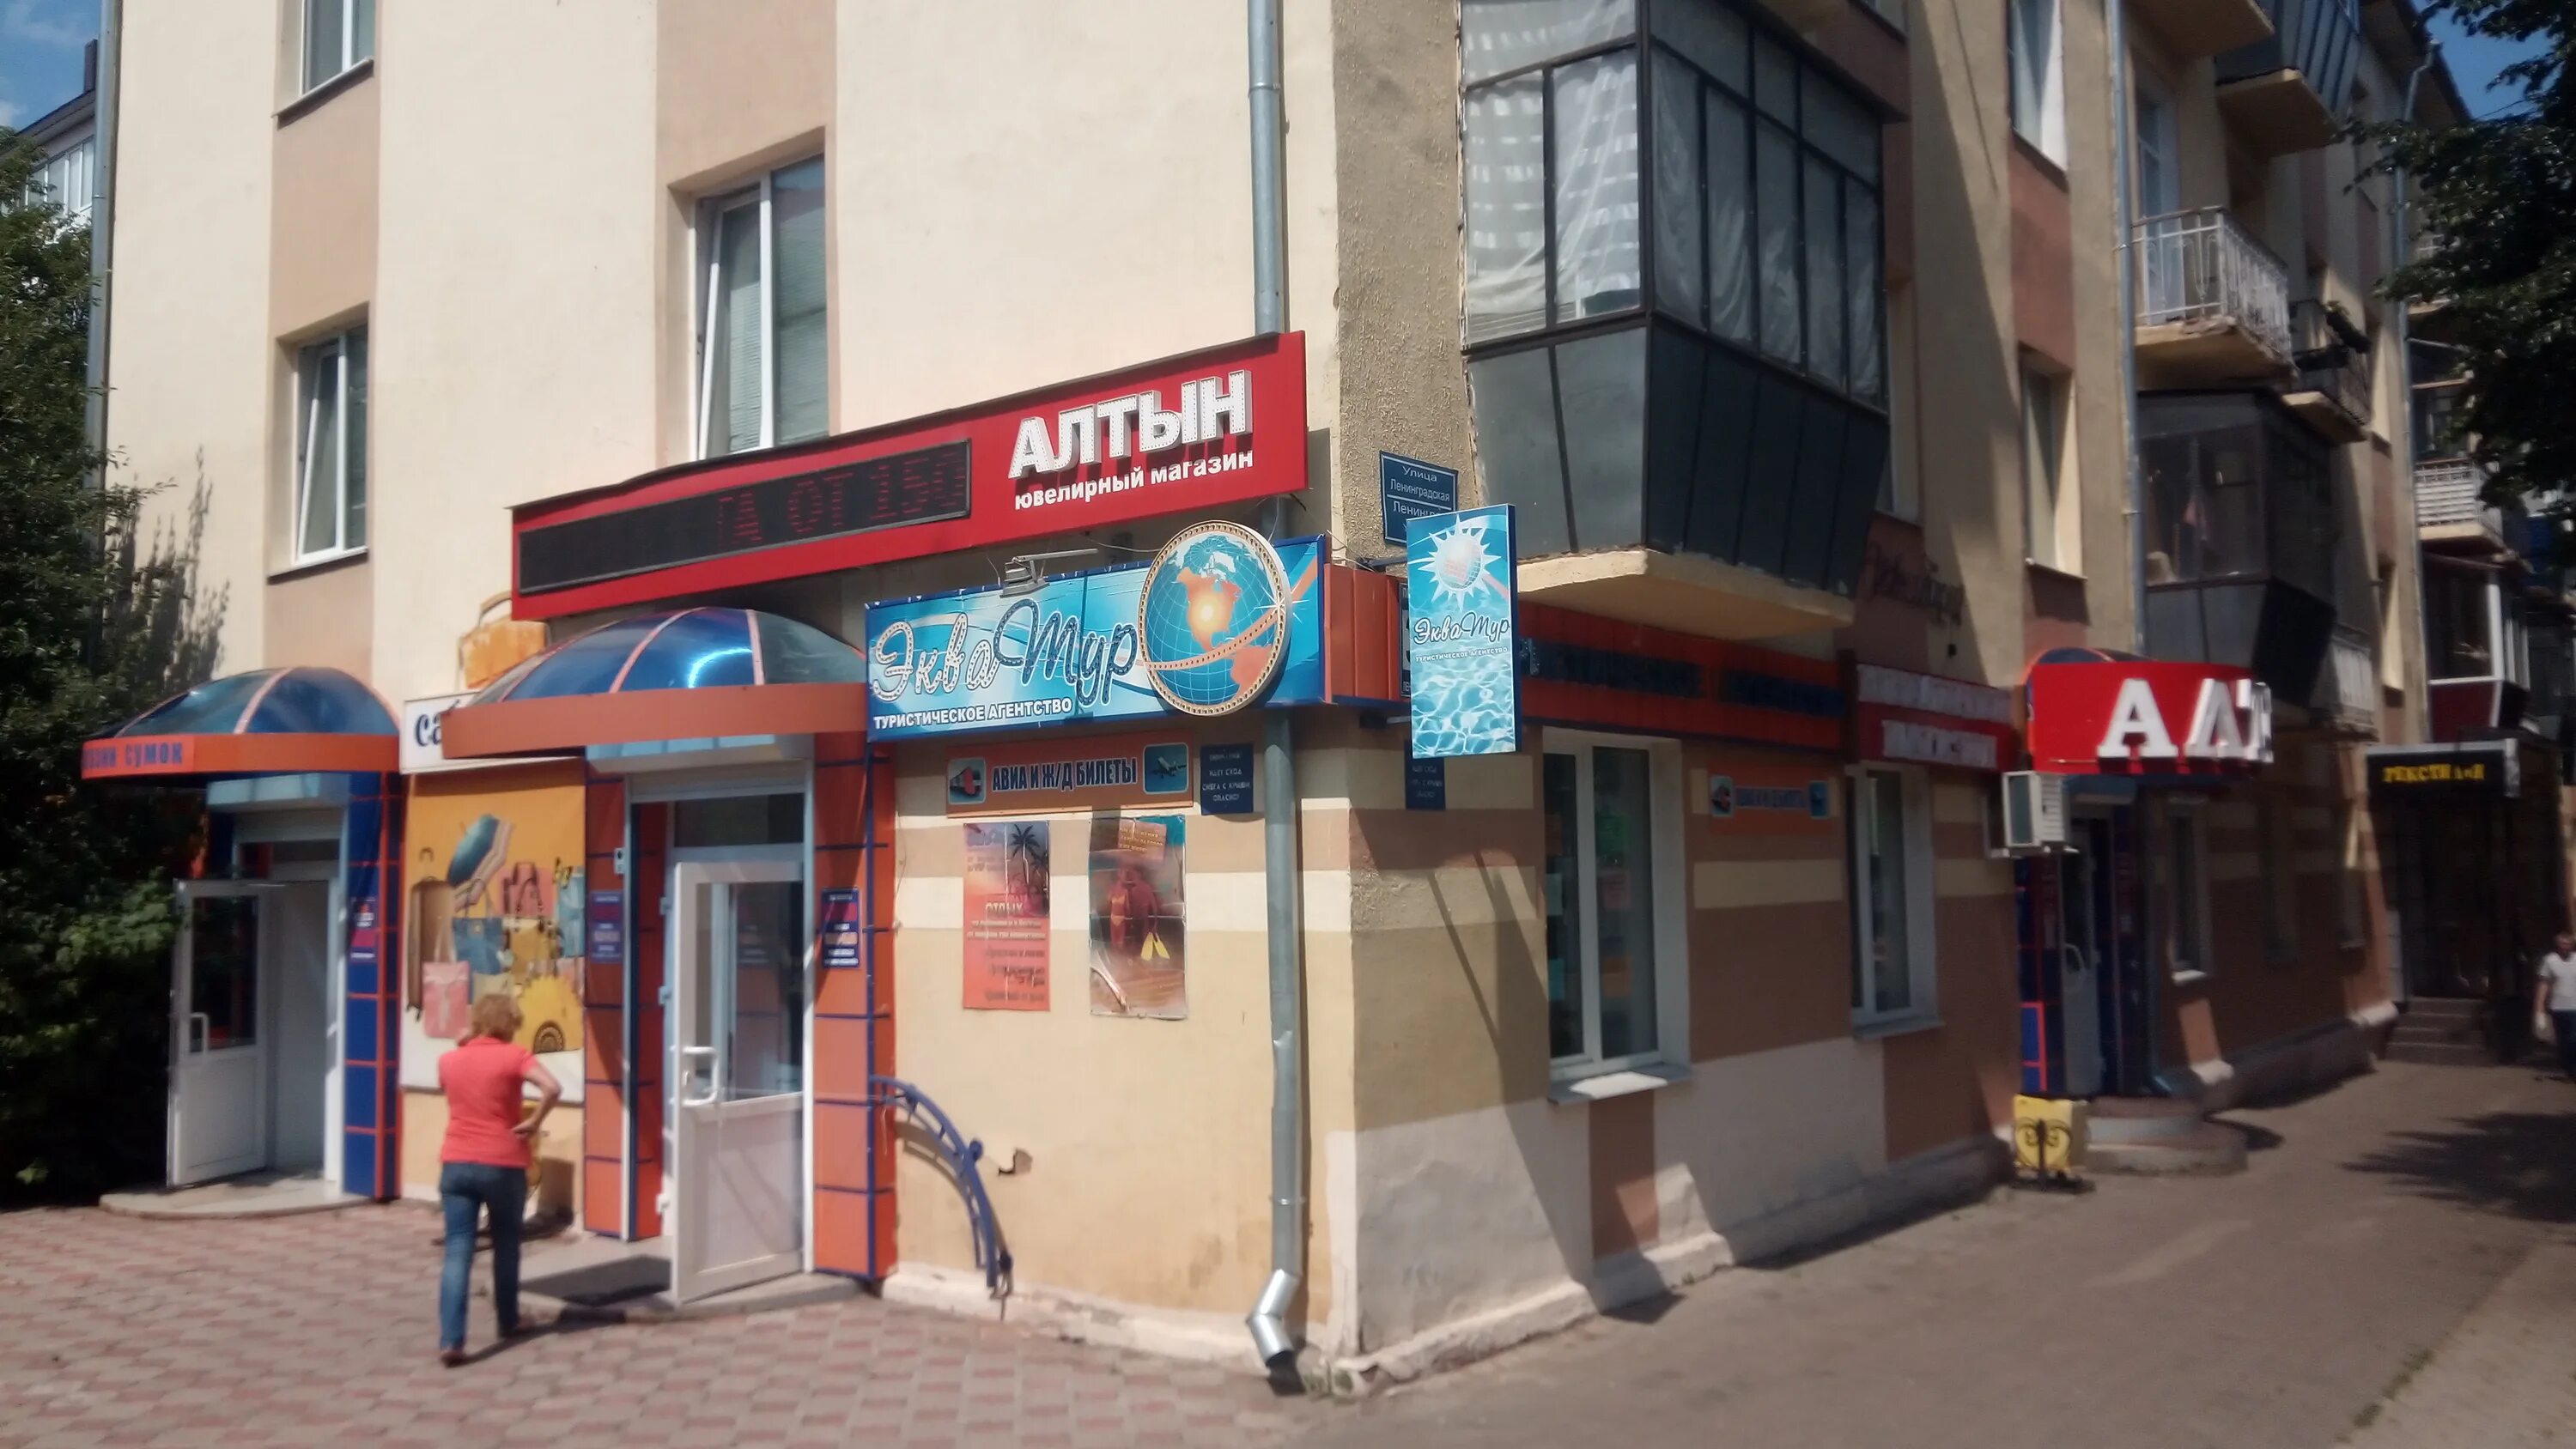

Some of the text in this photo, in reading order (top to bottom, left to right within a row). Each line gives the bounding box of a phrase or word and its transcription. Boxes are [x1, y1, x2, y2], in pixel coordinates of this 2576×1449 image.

[1008, 369, 1253, 479] АЛТЫН
[1015, 451, 1254, 511] ювелирный магазин
[1390, 478, 1450, 501] Ленинградская
[1402, 465, 1437, 482] Улица
[1416, 646, 1508, 662] ТУРИСТИЧЕСКОЕ АГЕНТСТВО
[873, 697, 1073, 730] ТУРИСТИЧЕСКОЕ АГЕНТСТВО
[993, 757, 1138, 791] АВИА И Ж/Д БИЛЕТЫ
